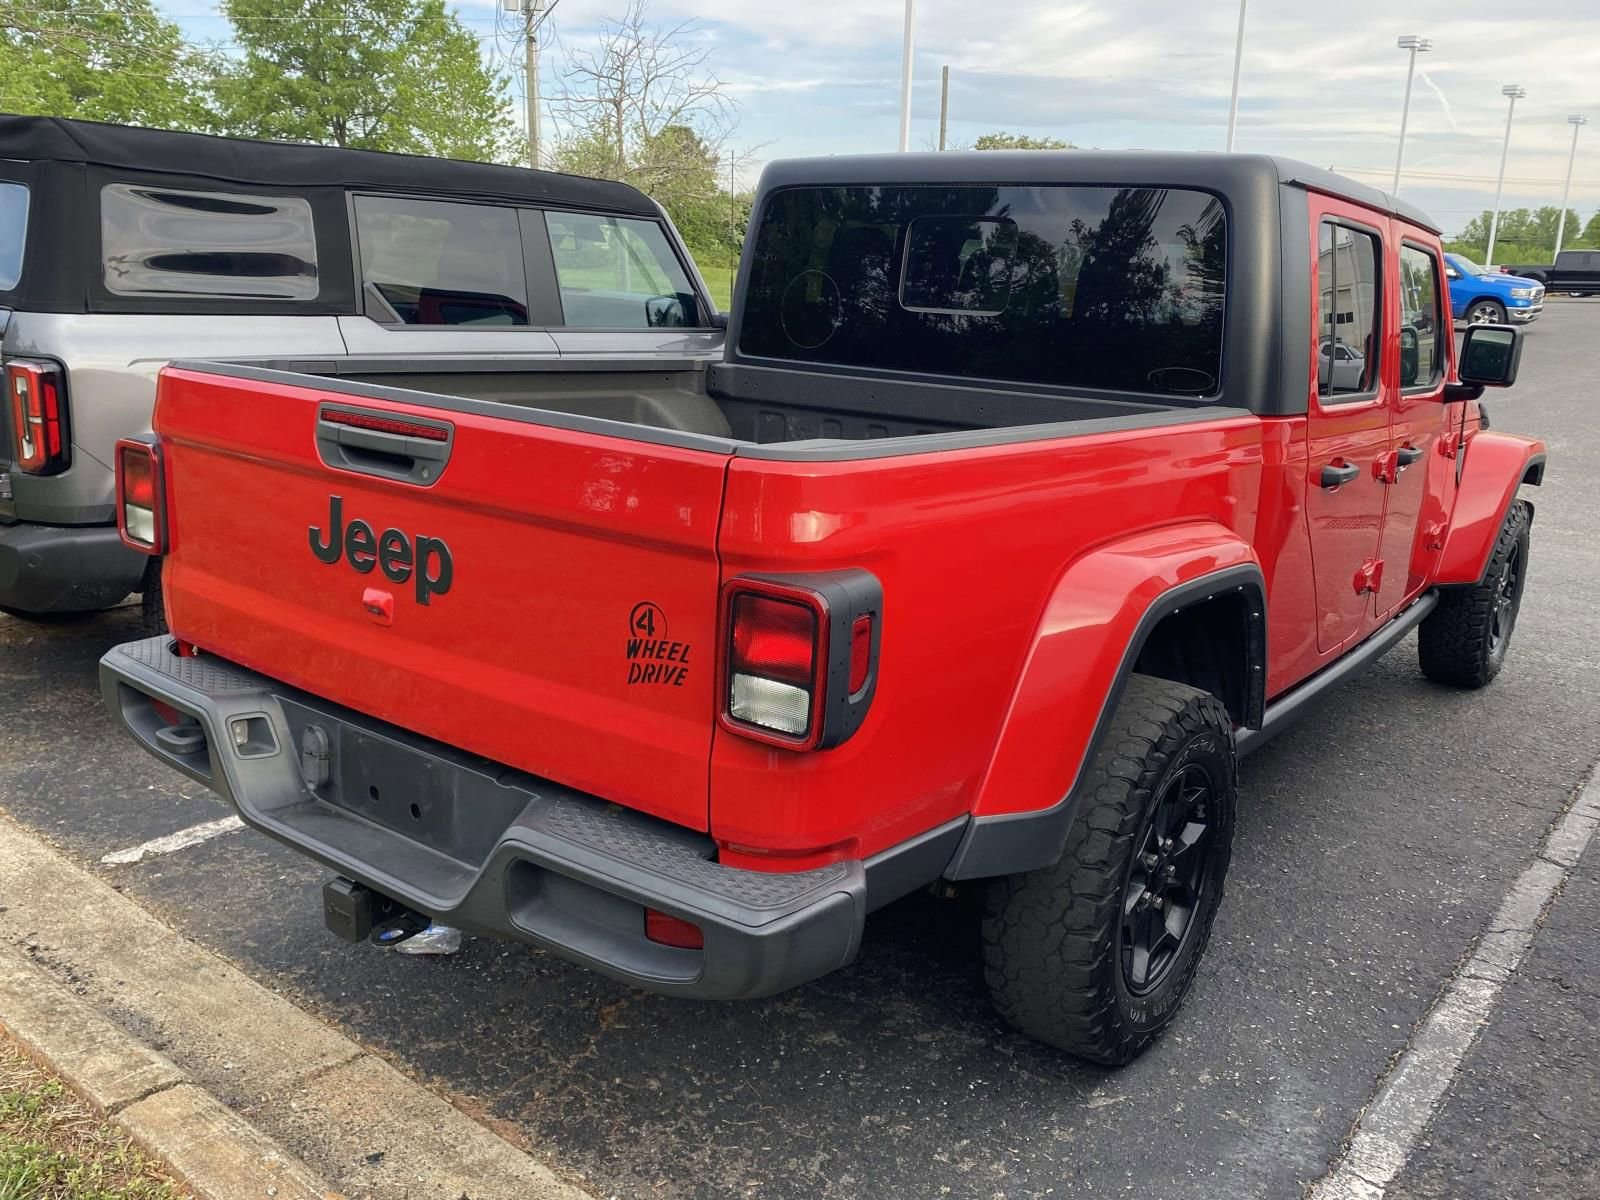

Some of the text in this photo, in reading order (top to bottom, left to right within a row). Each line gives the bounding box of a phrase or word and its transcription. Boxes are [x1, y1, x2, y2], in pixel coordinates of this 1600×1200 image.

[308, 494, 453, 606] Jeep
[635, 607, 656, 638] 4
[626, 638, 691, 664] WHEEL
[627, 662, 689, 686] DRIVE
